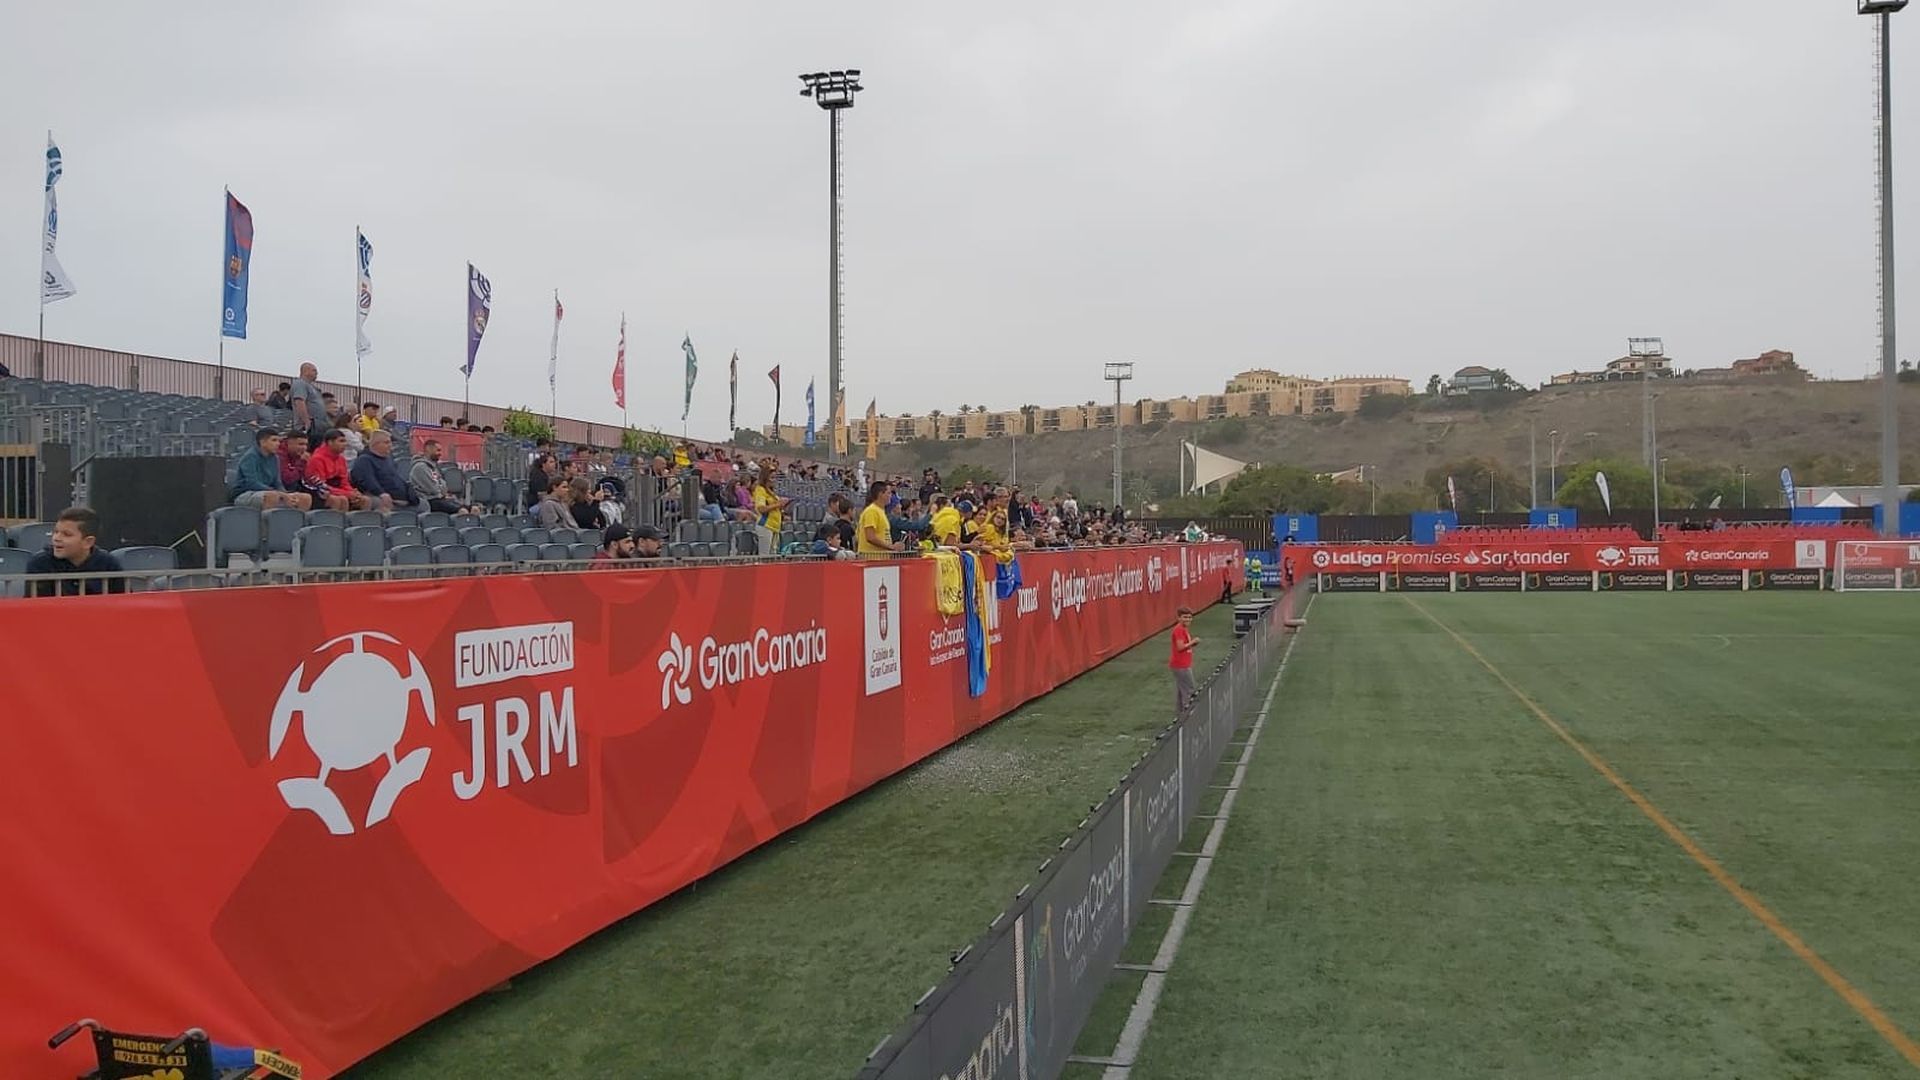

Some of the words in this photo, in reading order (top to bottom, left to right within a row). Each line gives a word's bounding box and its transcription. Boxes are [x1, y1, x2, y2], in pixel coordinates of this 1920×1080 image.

[1333, 551, 1382, 567] LaLiga
[1386, 551, 1460, 565] Promises
[1628, 555, 1660, 566] JRM
[1701, 549, 1769, 561] GranCanaria
[459, 627, 571, 680] FUNDACIÓN
[699, 619, 827, 690] GranCanaria
[452, 686, 578, 800] JRM
